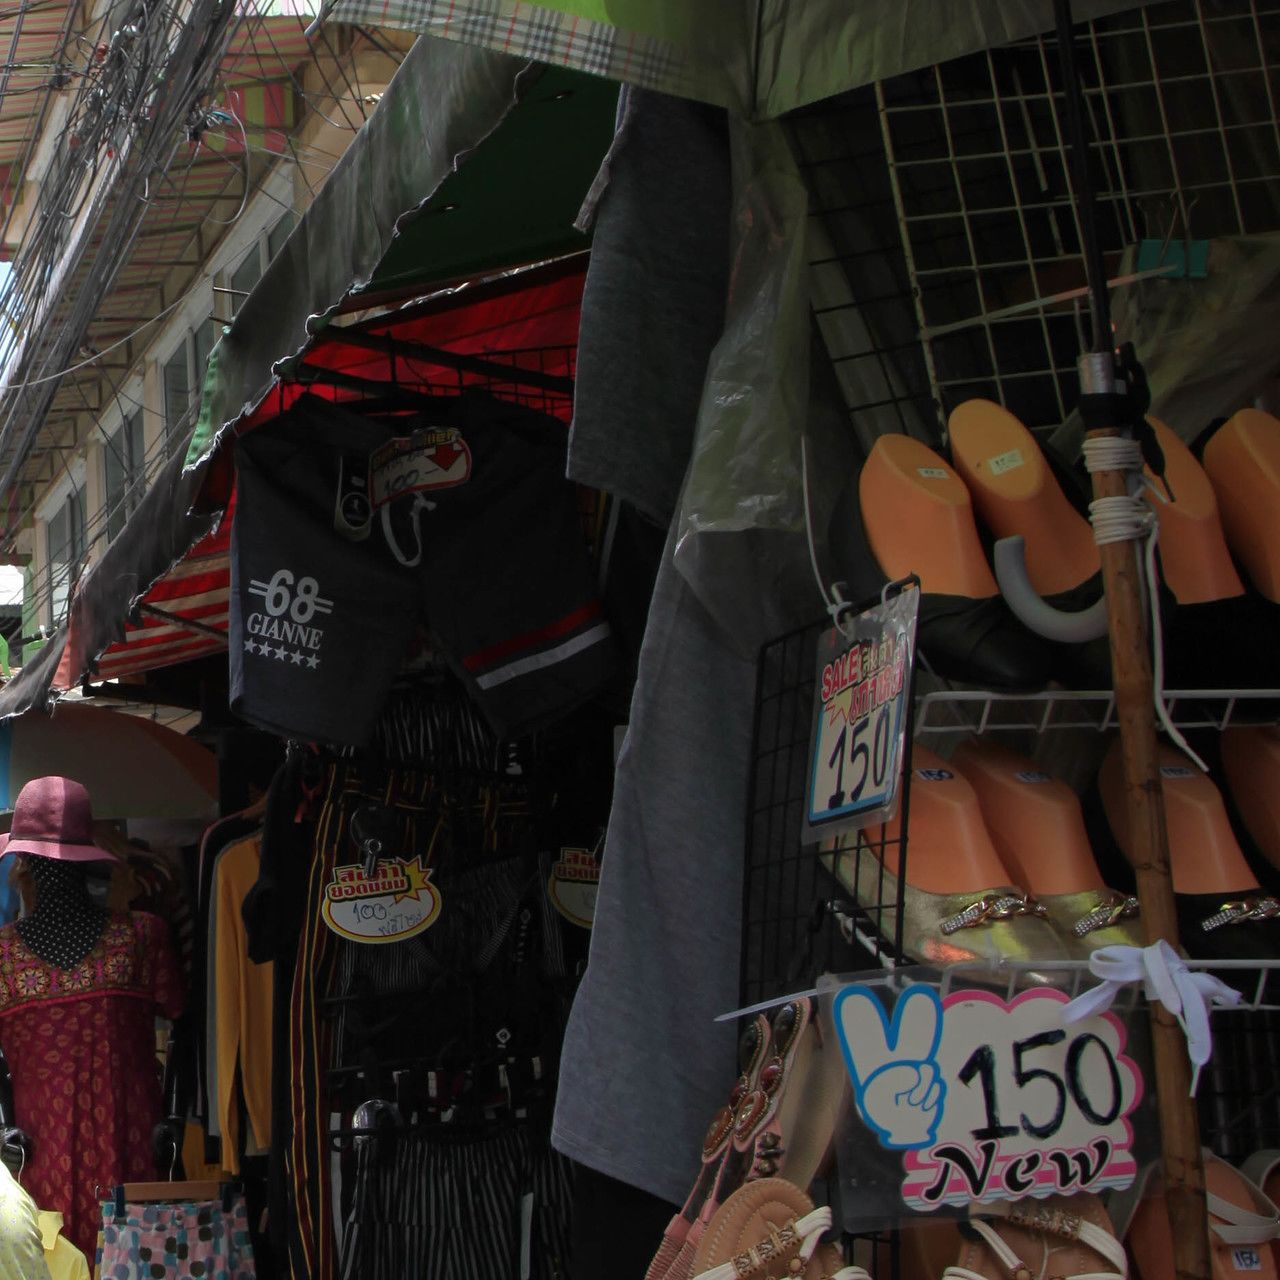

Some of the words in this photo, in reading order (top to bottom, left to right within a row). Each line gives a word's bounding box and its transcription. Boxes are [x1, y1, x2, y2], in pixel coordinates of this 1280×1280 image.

[265, 569, 319, 623] 68
[246, 612, 324, 650] GIANNE
[822, 644, 859, 700] SALE
[829, 703, 890, 810] 150
[920, 770, 953, 781] 150
[958, 1029, 1123, 1140] 150
[924, 1140, 1110, 1200] New
